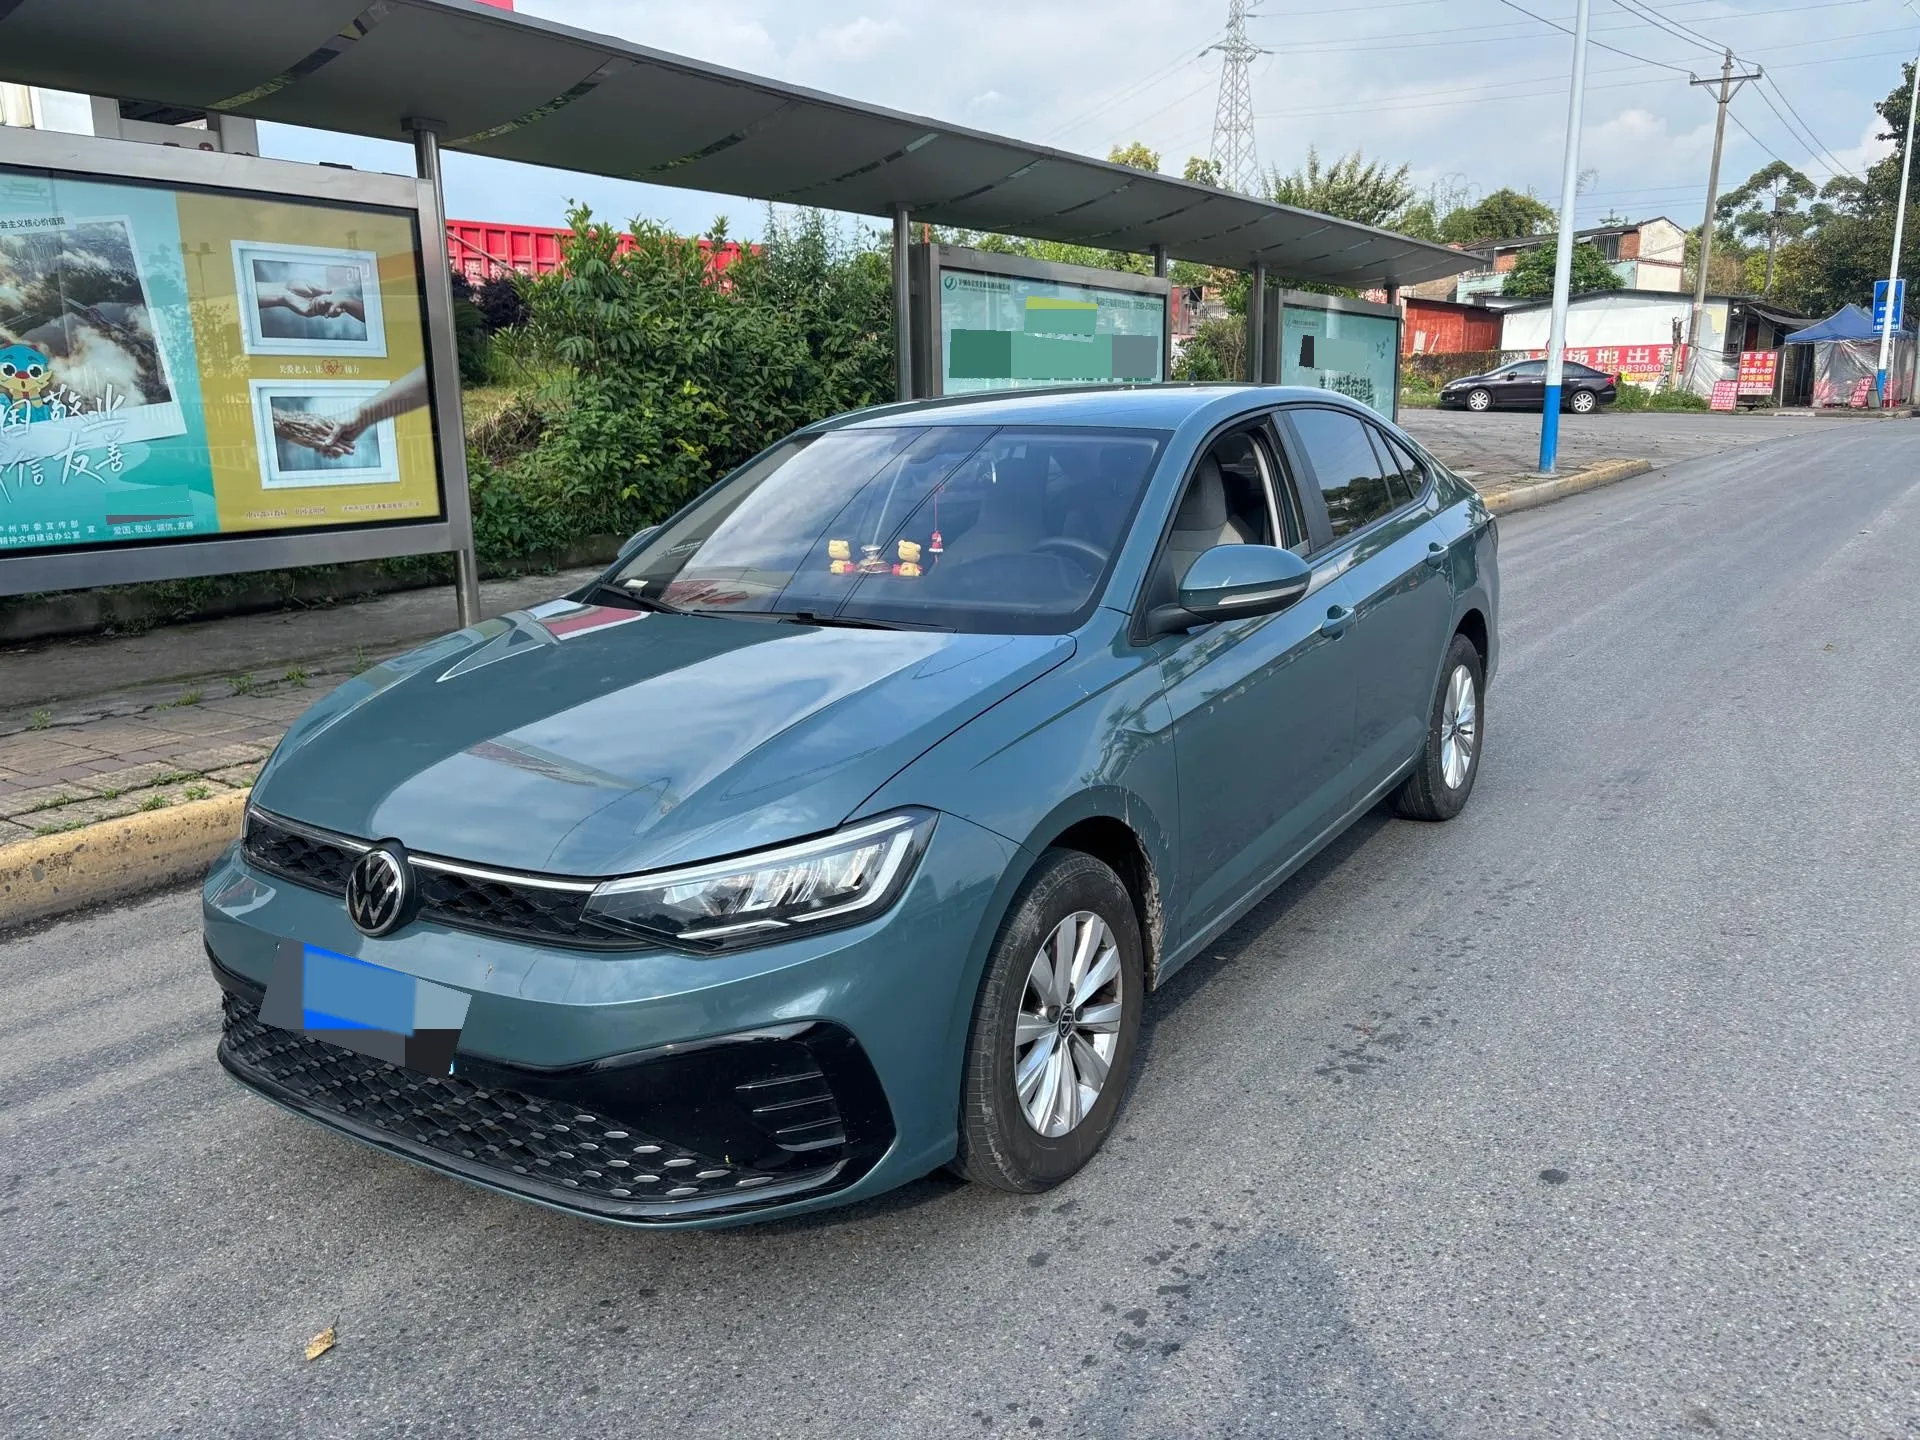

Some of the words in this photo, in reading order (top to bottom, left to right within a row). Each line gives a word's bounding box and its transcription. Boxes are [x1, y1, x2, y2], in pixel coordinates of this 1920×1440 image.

[0, 216, 66, 229] 会主义核心价值观
